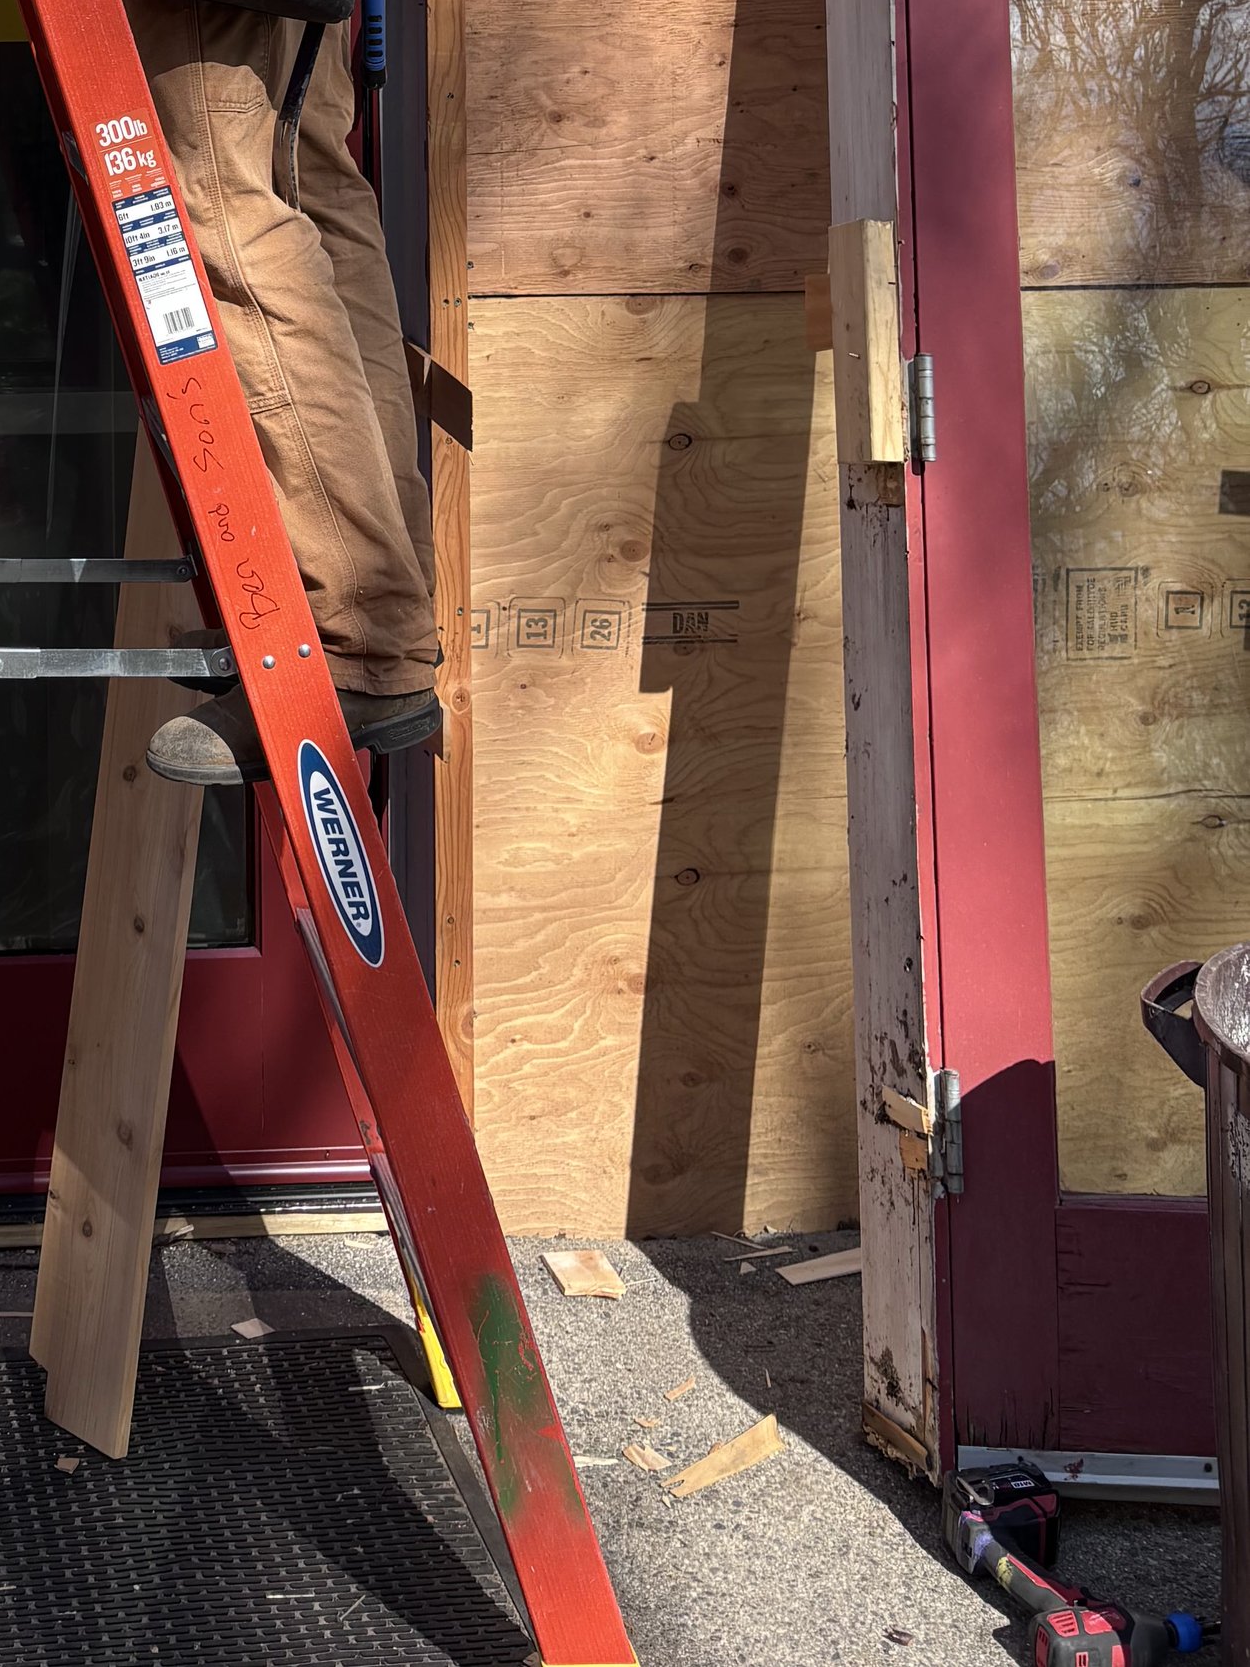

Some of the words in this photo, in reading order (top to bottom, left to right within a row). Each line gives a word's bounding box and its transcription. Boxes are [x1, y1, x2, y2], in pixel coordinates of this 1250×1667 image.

[104, 147, 137, 176] 136
[136, 150, 157, 168] kg
[132, 259, 144, 267] 3ft
[207, 502, 236, 542] and
[525, 616, 549, 641] 13
[589, 618, 612, 643] 26
[672, 611, 710, 634] DAN
[313, 787, 370, 922] WERNER
